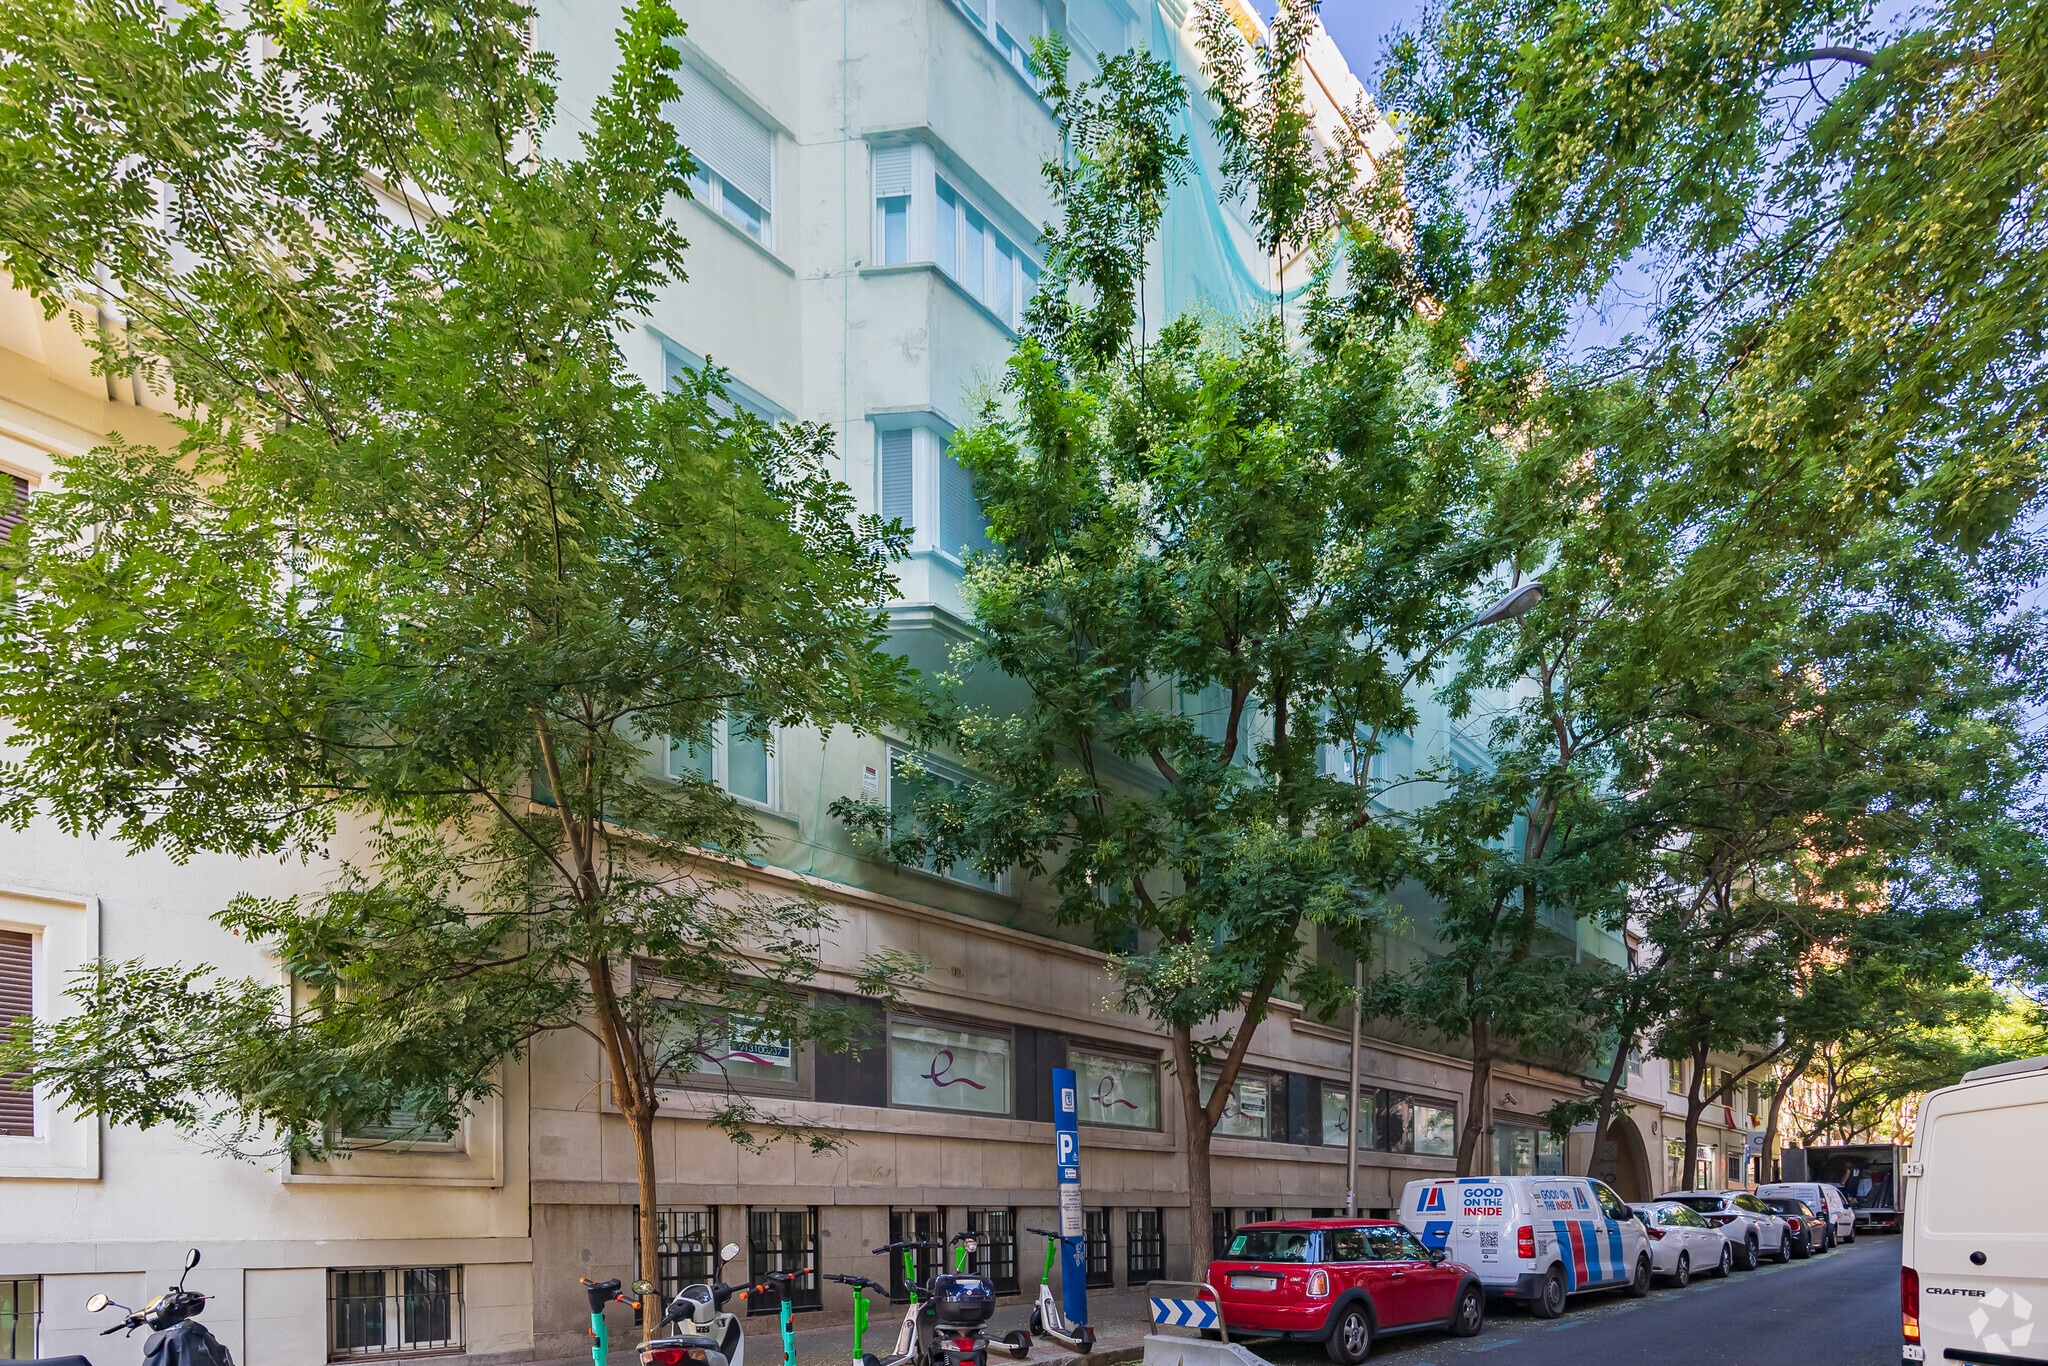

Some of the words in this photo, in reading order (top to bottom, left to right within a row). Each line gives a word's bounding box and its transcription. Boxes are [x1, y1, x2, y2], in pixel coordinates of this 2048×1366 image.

[1059, 1134, 1073, 1163] P
[1463, 1188, 1503, 1198] GOOD
[1540, 1189, 1560, 1199] GOOD
[1560, 1189, 1570, 1199] ON
[1463, 1198, 1481, 1207] ON
[1482, 1198, 1503, 1206] THE
[1544, 1200, 1556, 1210] THE
[1555, 1200, 1574, 1210] INSIDE
[1463, 1207, 1503, 1216] INSIDE
[1925, 1287, 1986, 1297] CRAFTER
